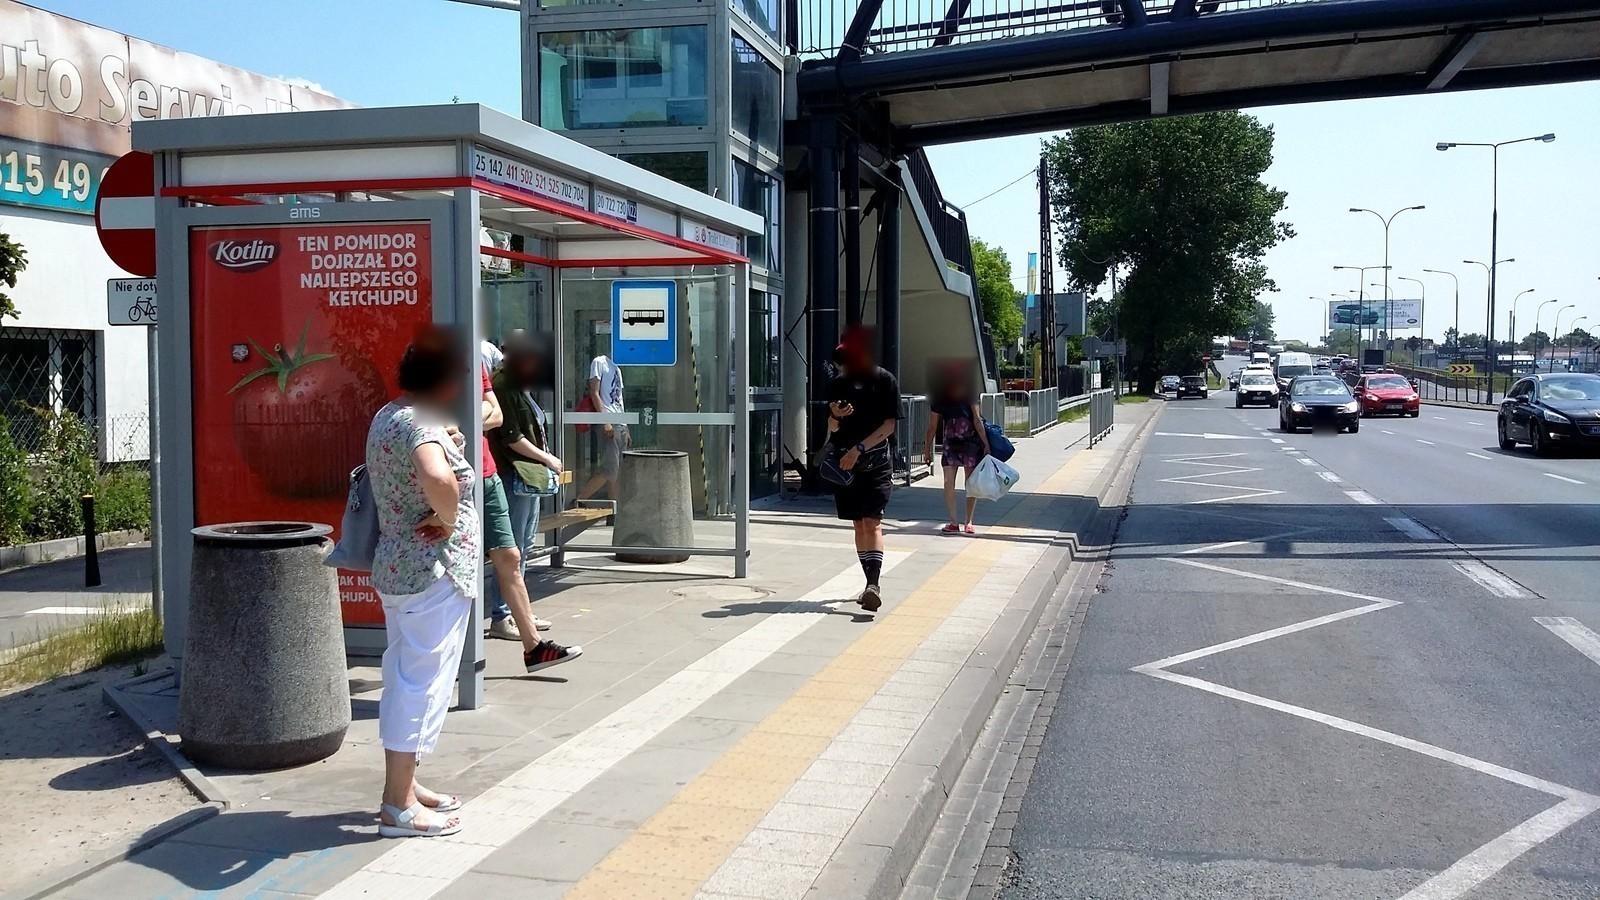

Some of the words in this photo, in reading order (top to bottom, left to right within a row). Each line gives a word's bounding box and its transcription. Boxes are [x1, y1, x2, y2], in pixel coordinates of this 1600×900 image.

[99, 54, 254, 124] Serwi
[0, 150, 44, 195] 15
[54, 159, 90, 202] 49
[475, 154, 486, 172] 25
[489, 158, 503, 177] 142
[506, 164, 518, 181] 411
[520, 168, 533, 186] 502
[535, 173, 546, 190] 521
[548, 178, 560, 195] 525
[561, 182, 572, 199] 702
[573, 186, 584, 202] 704
[290, 207, 321, 219] ams
[215, 239, 275, 261] Kotlin
[298, 235, 329, 252] TEN
[334, 232, 416, 251] POMIDOR
[311, 253, 386, 270] DOJRZAŁ
[391, 251, 417, 268] DO
[115, 281, 133, 292] Nie
[300, 270, 418, 289] NAJLEPSZEGO
[329, 289, 418, 307] KETCHUPU
[338, 575, 354, 586] AK
[340, 591, 377, 603] HUPU.
